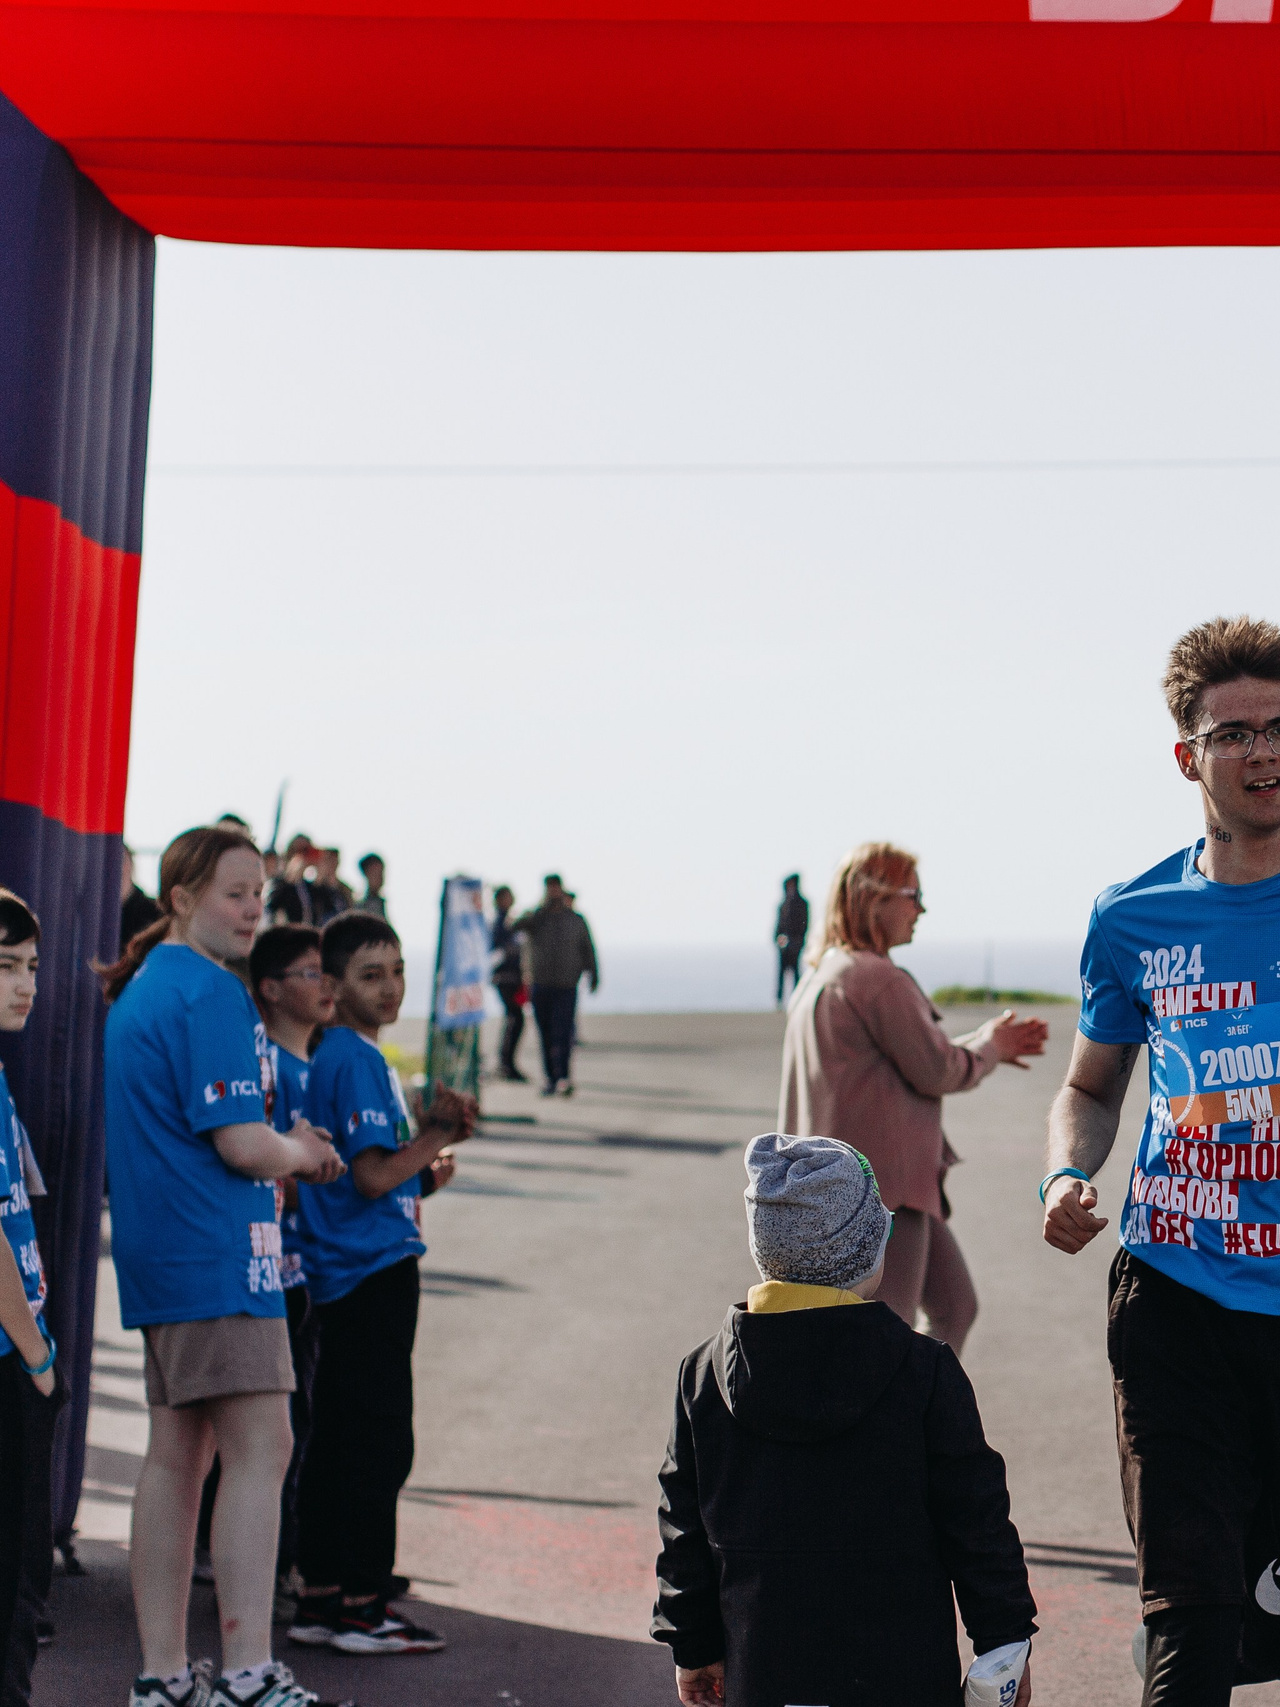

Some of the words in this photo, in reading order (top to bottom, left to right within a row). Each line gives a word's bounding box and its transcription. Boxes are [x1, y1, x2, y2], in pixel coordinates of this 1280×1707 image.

[1139, 944, 1205, 990] 2024
[1184, 1018, 1208, 1029] ПСБ
[1130, 1168, 1239, 1220] ЛЮБОВЬ
